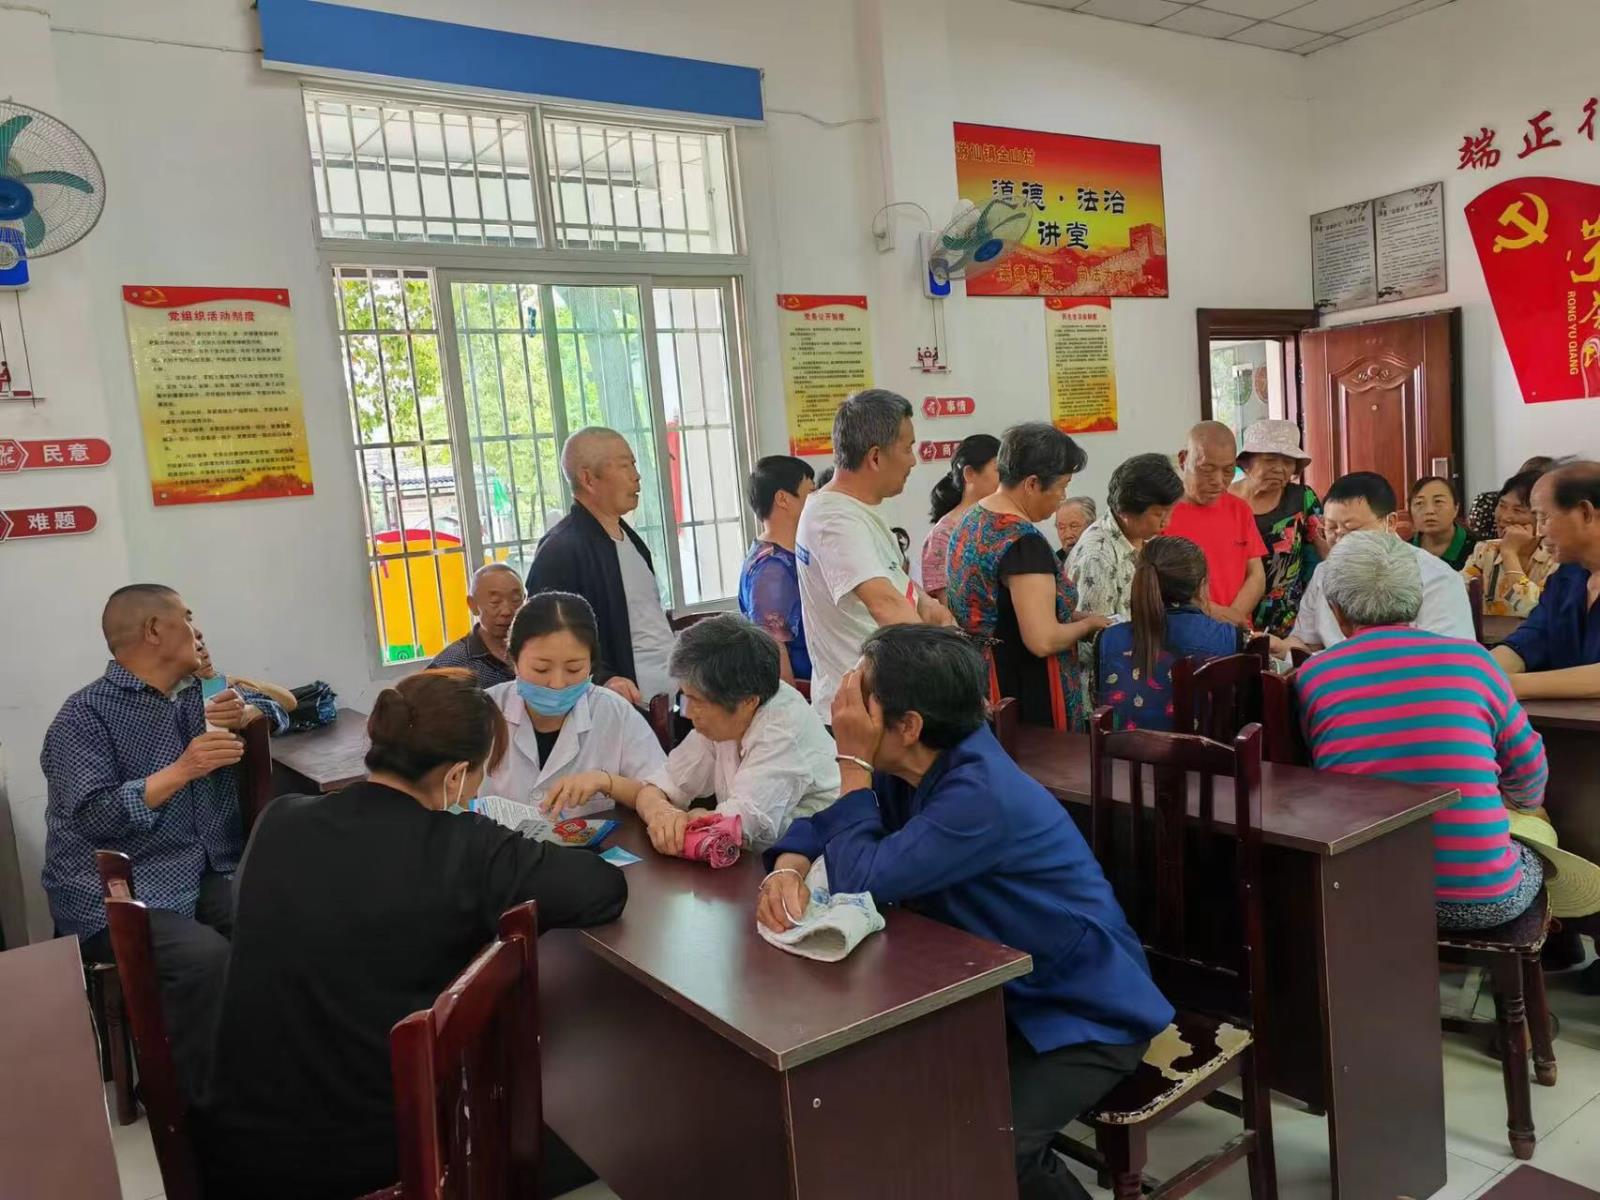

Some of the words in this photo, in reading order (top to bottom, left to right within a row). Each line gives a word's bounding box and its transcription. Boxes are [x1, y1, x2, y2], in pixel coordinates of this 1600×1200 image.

[1037, 220, 1089, 250] 讲堂
[168, 310, 256, 322] 党组织活动制度
[1567, 291, 1577, 322] RONG
[1567, 324, 1578, 339] YU
[1568, 341, 1579, 375] QIANG
[27, 510, 77, 532] 难题
